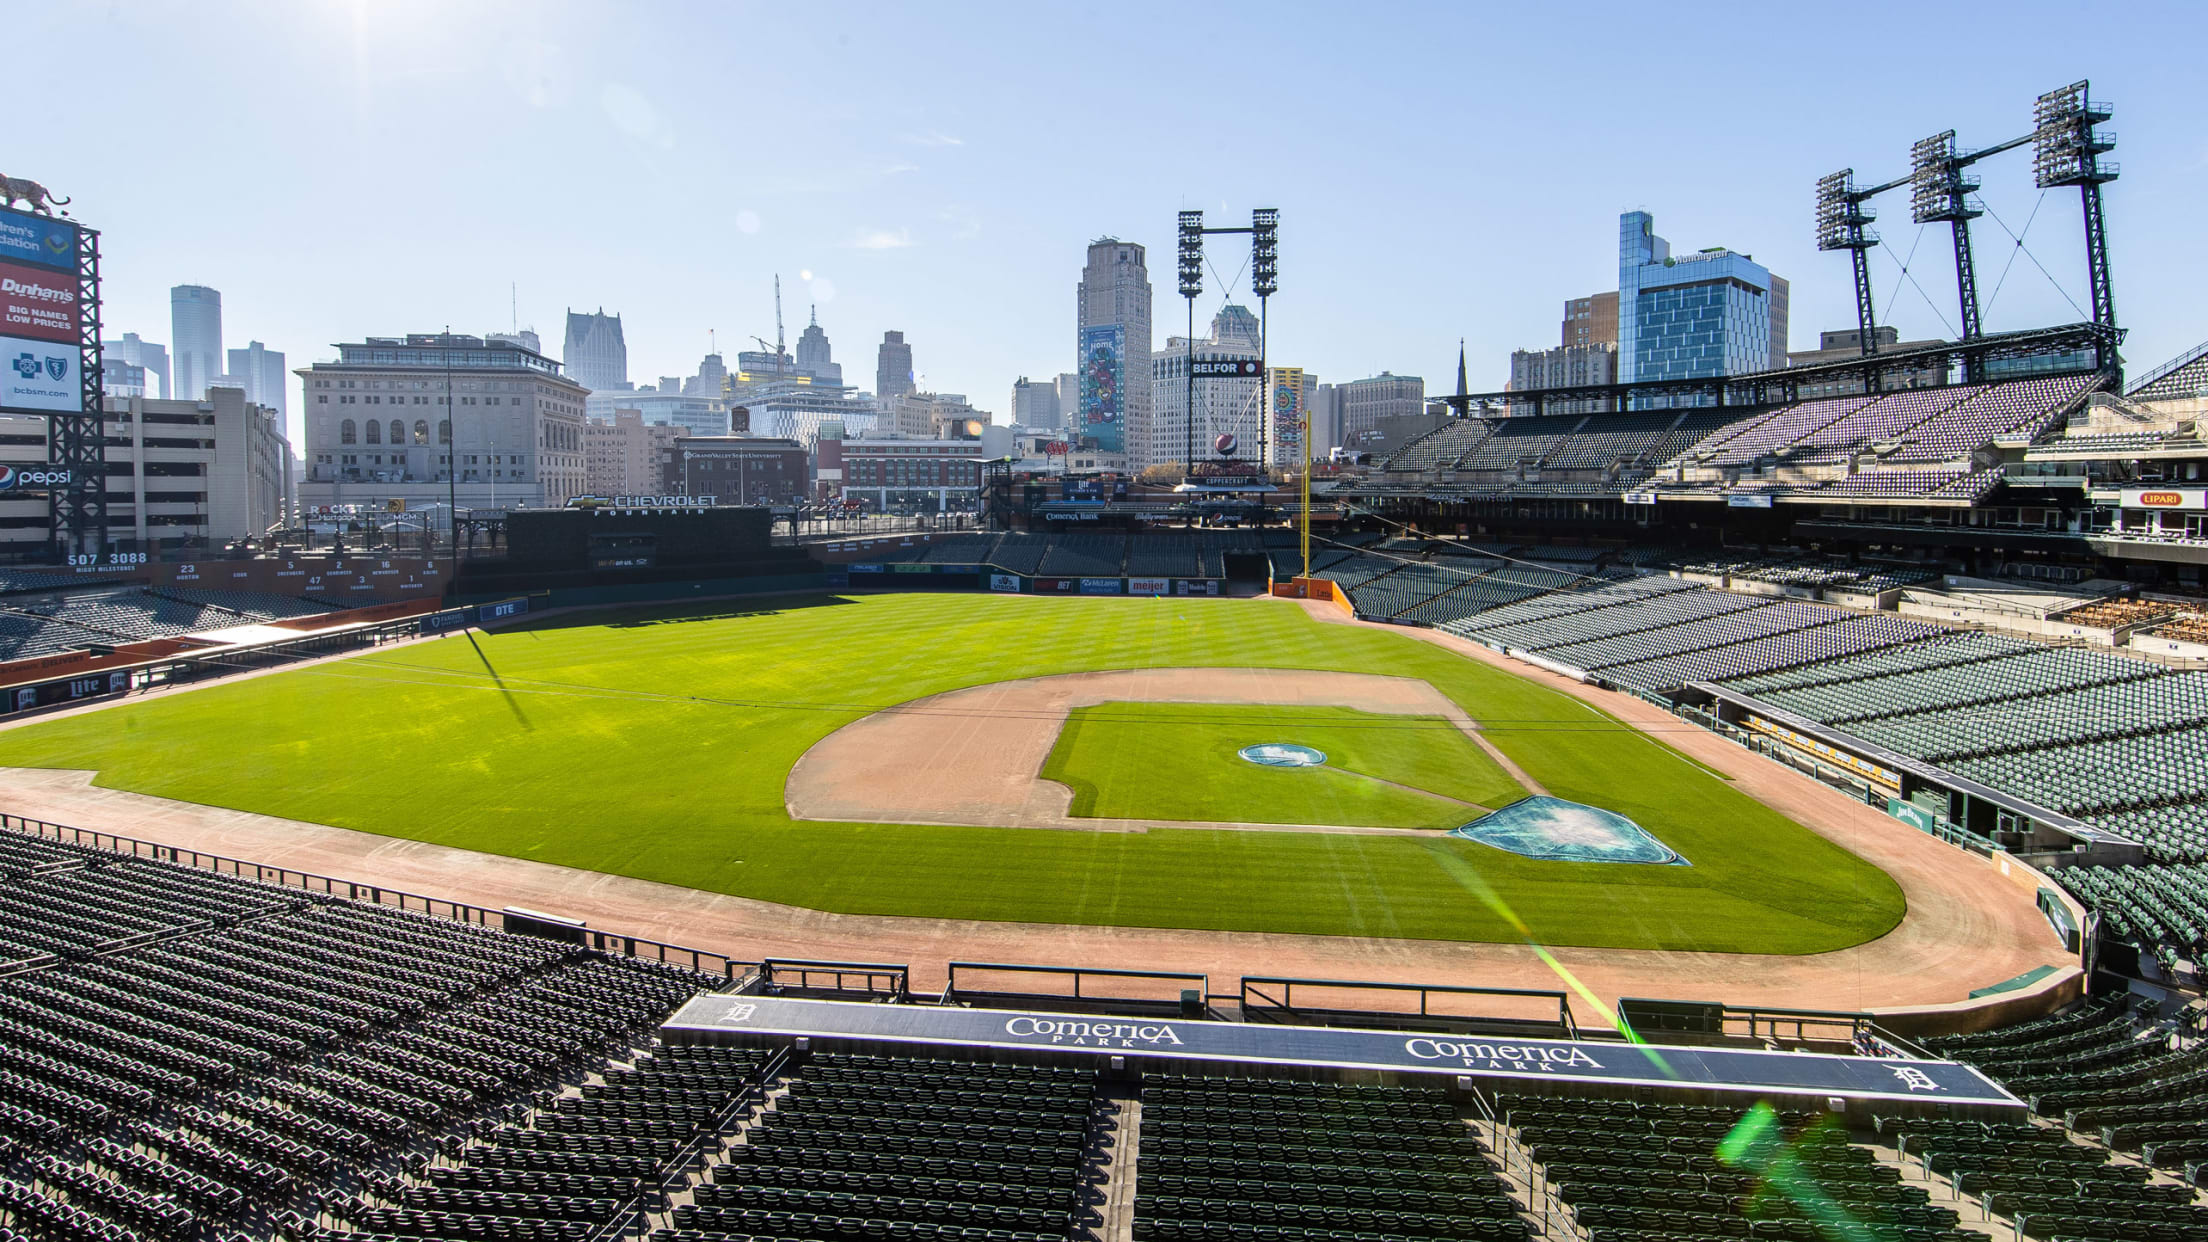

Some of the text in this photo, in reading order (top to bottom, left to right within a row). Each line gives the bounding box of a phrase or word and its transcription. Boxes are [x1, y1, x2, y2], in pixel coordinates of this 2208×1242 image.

[1676, 250, 1728, 264] Huntington
[1, 278, 74, 302] Dunham's
[9, 305, 68, 321] BIG NAMES
[6, 314, 72, 330] LOW PRICES
[1193, 363, 1237, 373] BELFOR
[14, 387, 69, 398] bcbsm.com
[19, 469, 71, 486] pepsi
[615, 495, 718, 507] CHEVROLET
[2144, 495, 2177, 503] LIPARI
[310, 504, 364, 513] ROCKET
[68, 553, 147, 566] 507 3088
[287, 561, 294, 569] 5
[336, 561, 342, 569] 2
[381, 561, 390, 569] 16
[181, 564, 195, 574] 23
[309, 576, 321, 585] 47
[1133, 580, 1164, 592] meijer
[495, 604, 515, 616] DTE
[70, 679, 99, 698] Lite
[1052, 1035, 1134, 1048] PARK
[1462, 1058, 1555, 1072] PARK
